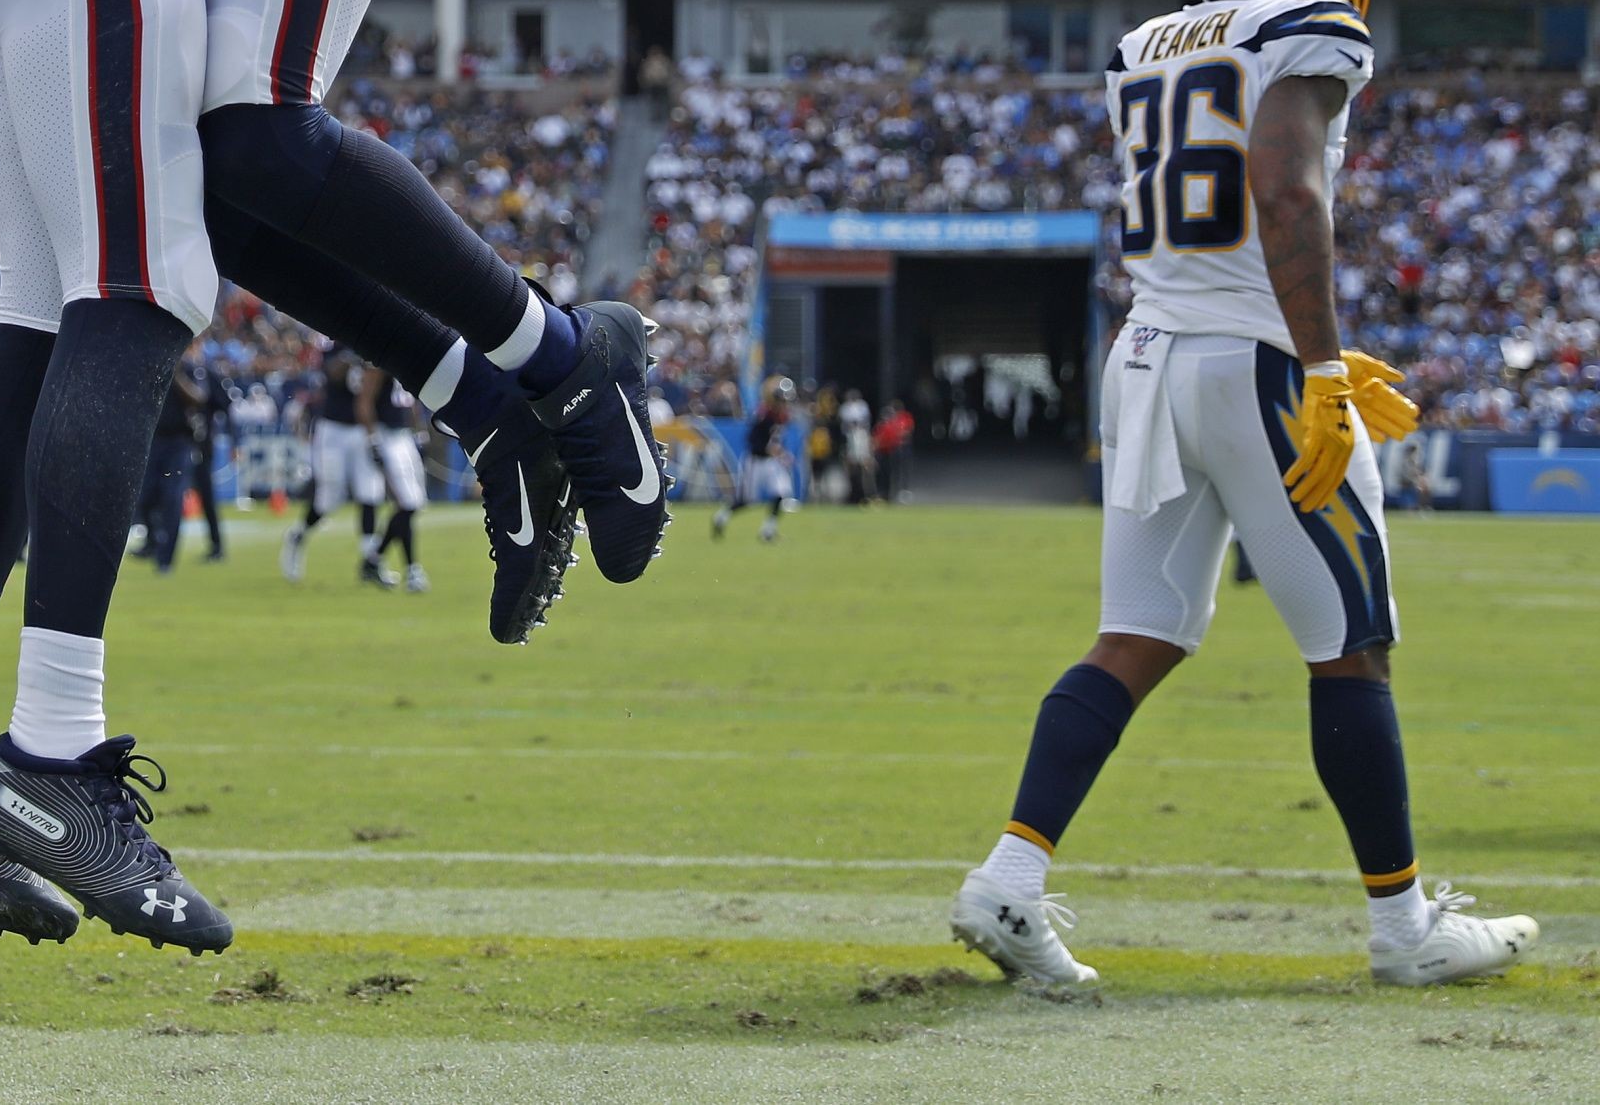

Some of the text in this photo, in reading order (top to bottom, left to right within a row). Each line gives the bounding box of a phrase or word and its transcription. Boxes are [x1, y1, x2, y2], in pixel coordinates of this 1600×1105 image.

[1138, 8, 1240, 65] TEAMER
[1119, 56, 1250, 261] 36
[562, 388, 593, 416] ALPHA
[23, 810, 60, 834] NITRO
